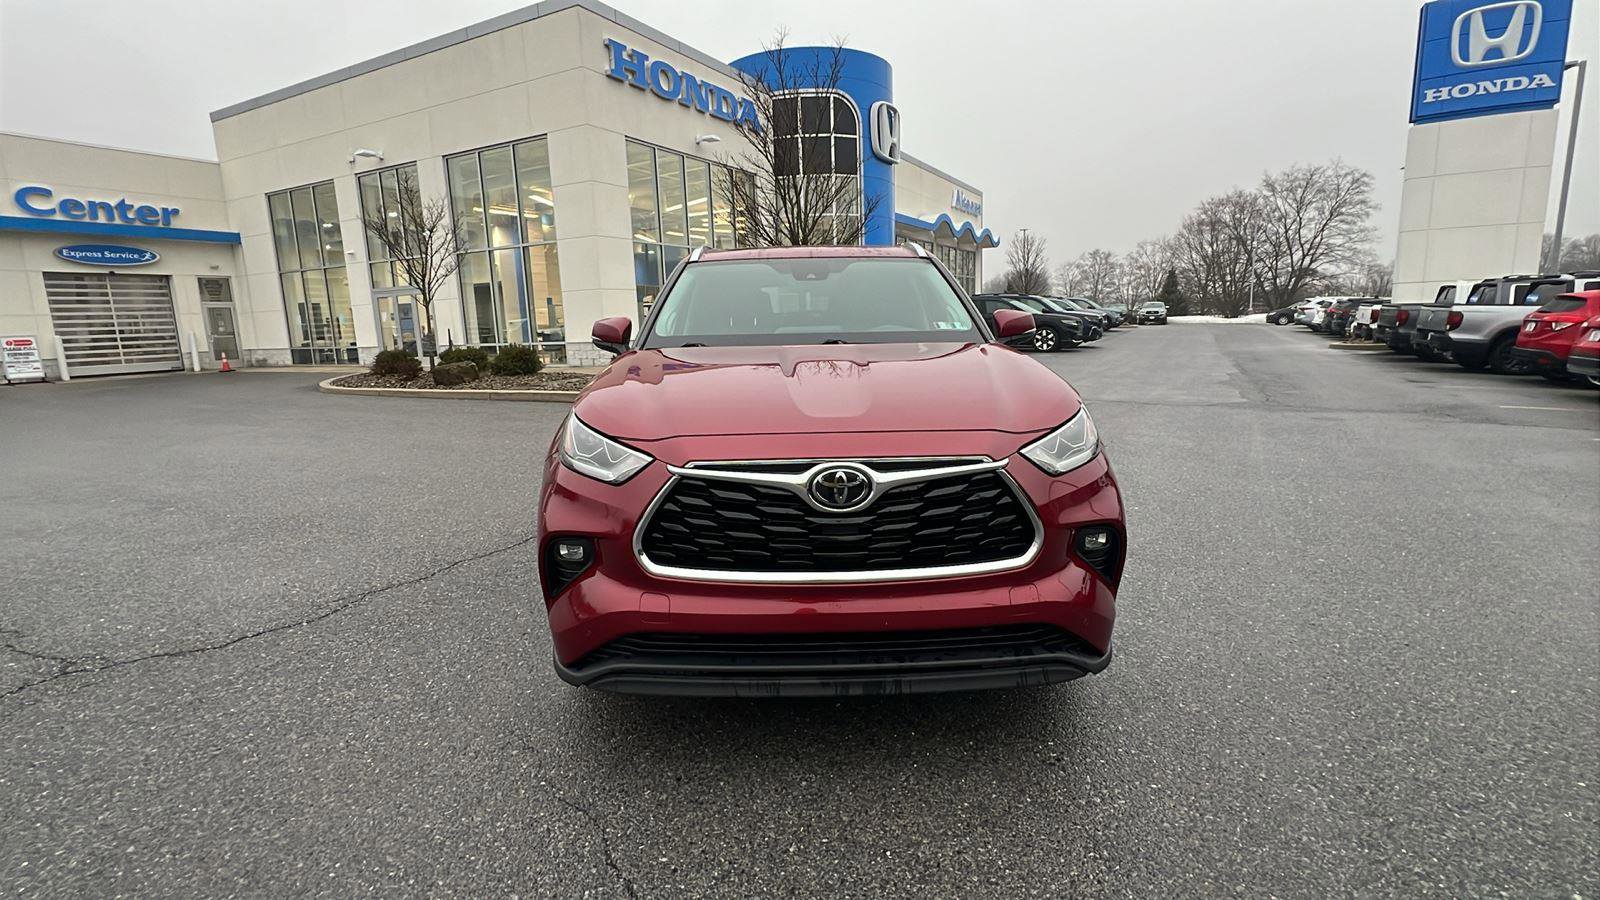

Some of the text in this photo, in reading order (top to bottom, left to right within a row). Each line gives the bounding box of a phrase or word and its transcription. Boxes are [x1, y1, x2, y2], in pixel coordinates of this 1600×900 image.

[604, 38, 763, 134] HONDA
[1423, 73, 1556, 104] HONDA
[14, 186, 180, 226] Center
[62, 248, 140, 259] Express Service
